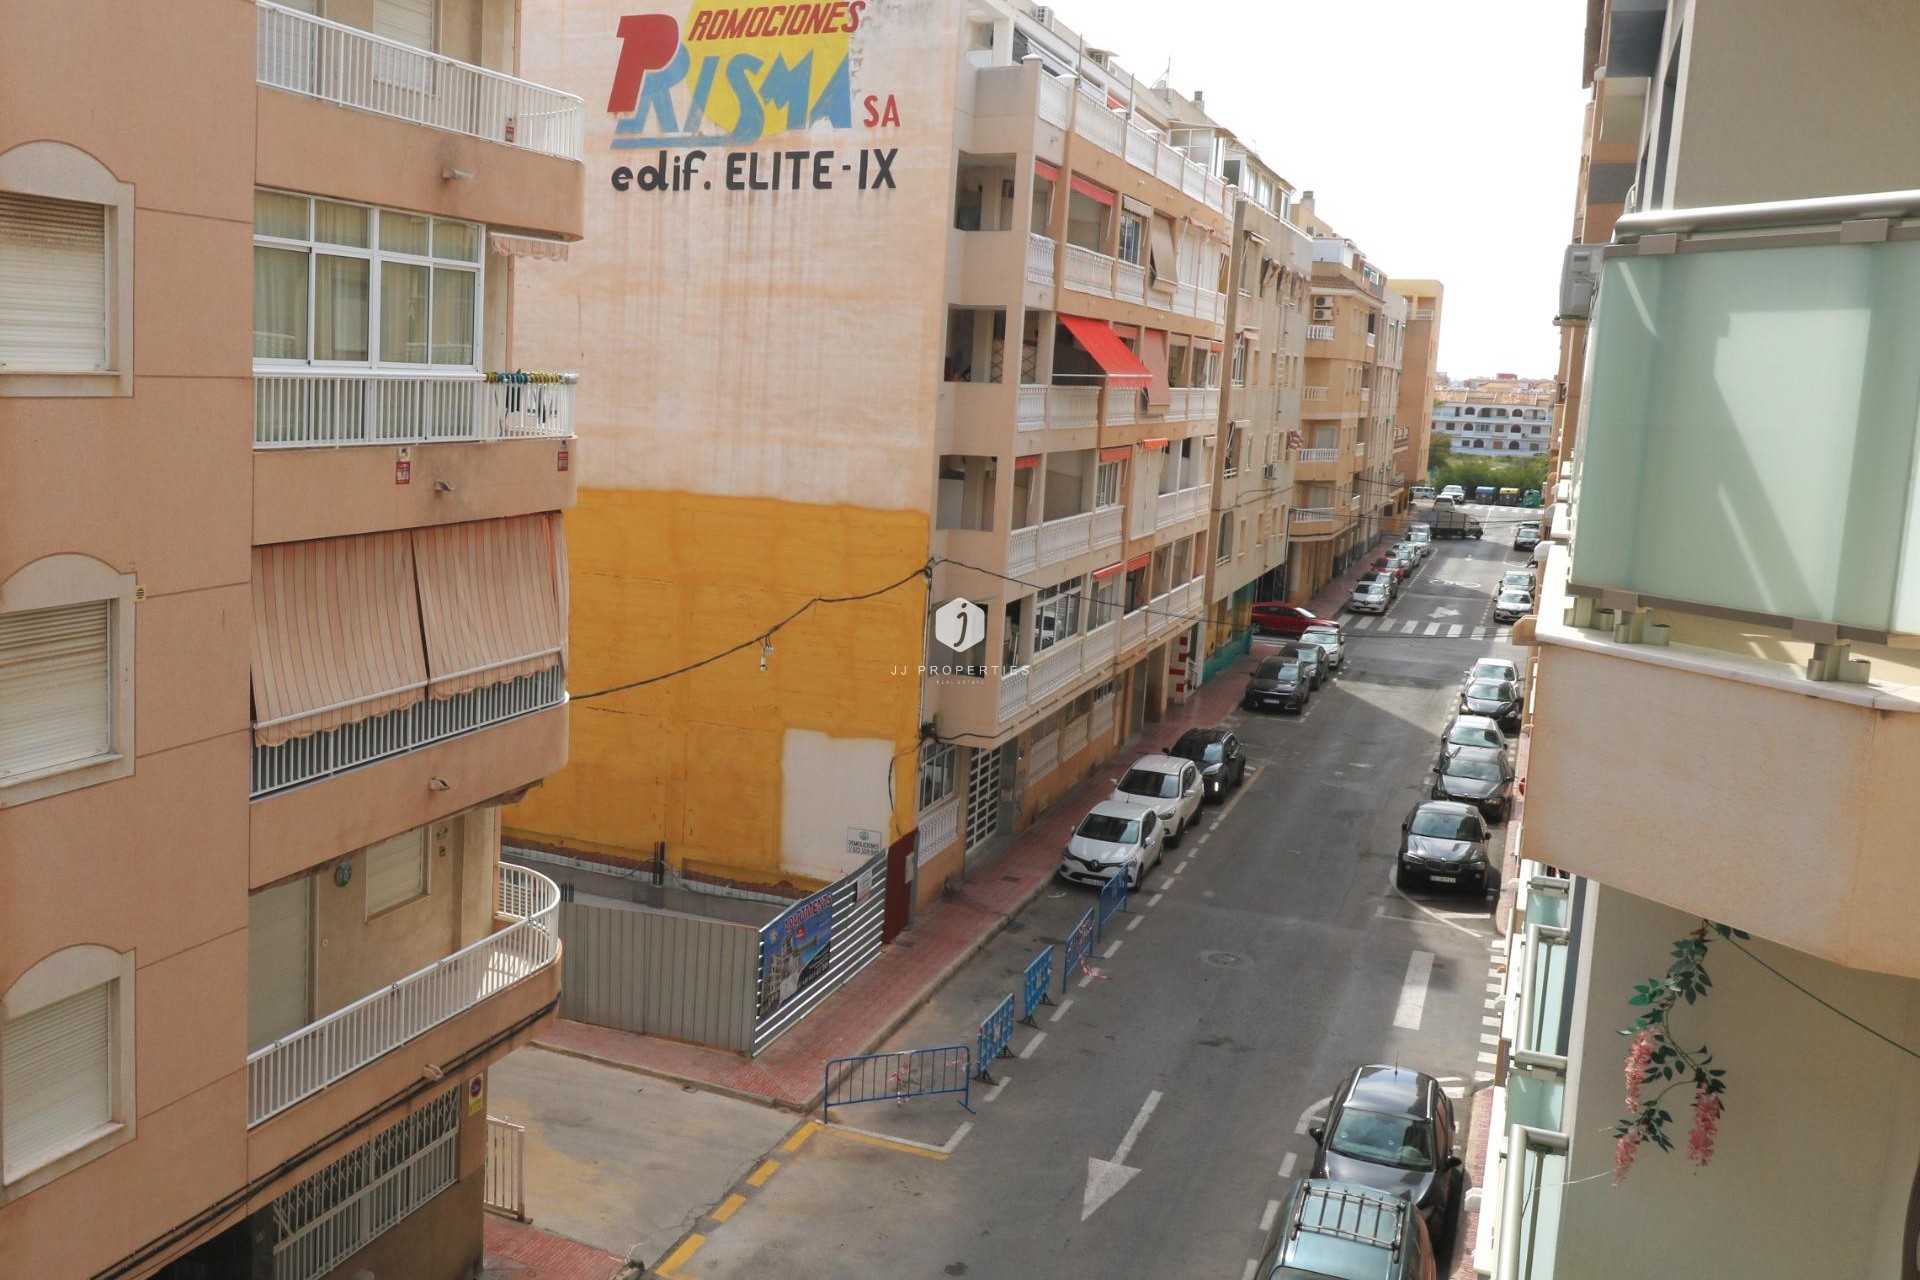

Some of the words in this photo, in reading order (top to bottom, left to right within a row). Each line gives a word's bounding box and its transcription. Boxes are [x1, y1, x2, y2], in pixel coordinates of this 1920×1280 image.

[607, 13, 852, 148] PRISMA
[863, 94, 900, 128] SA
[611, 149, 711, 191] edif.
[725, 148, 899, 190] ELITE-IX
